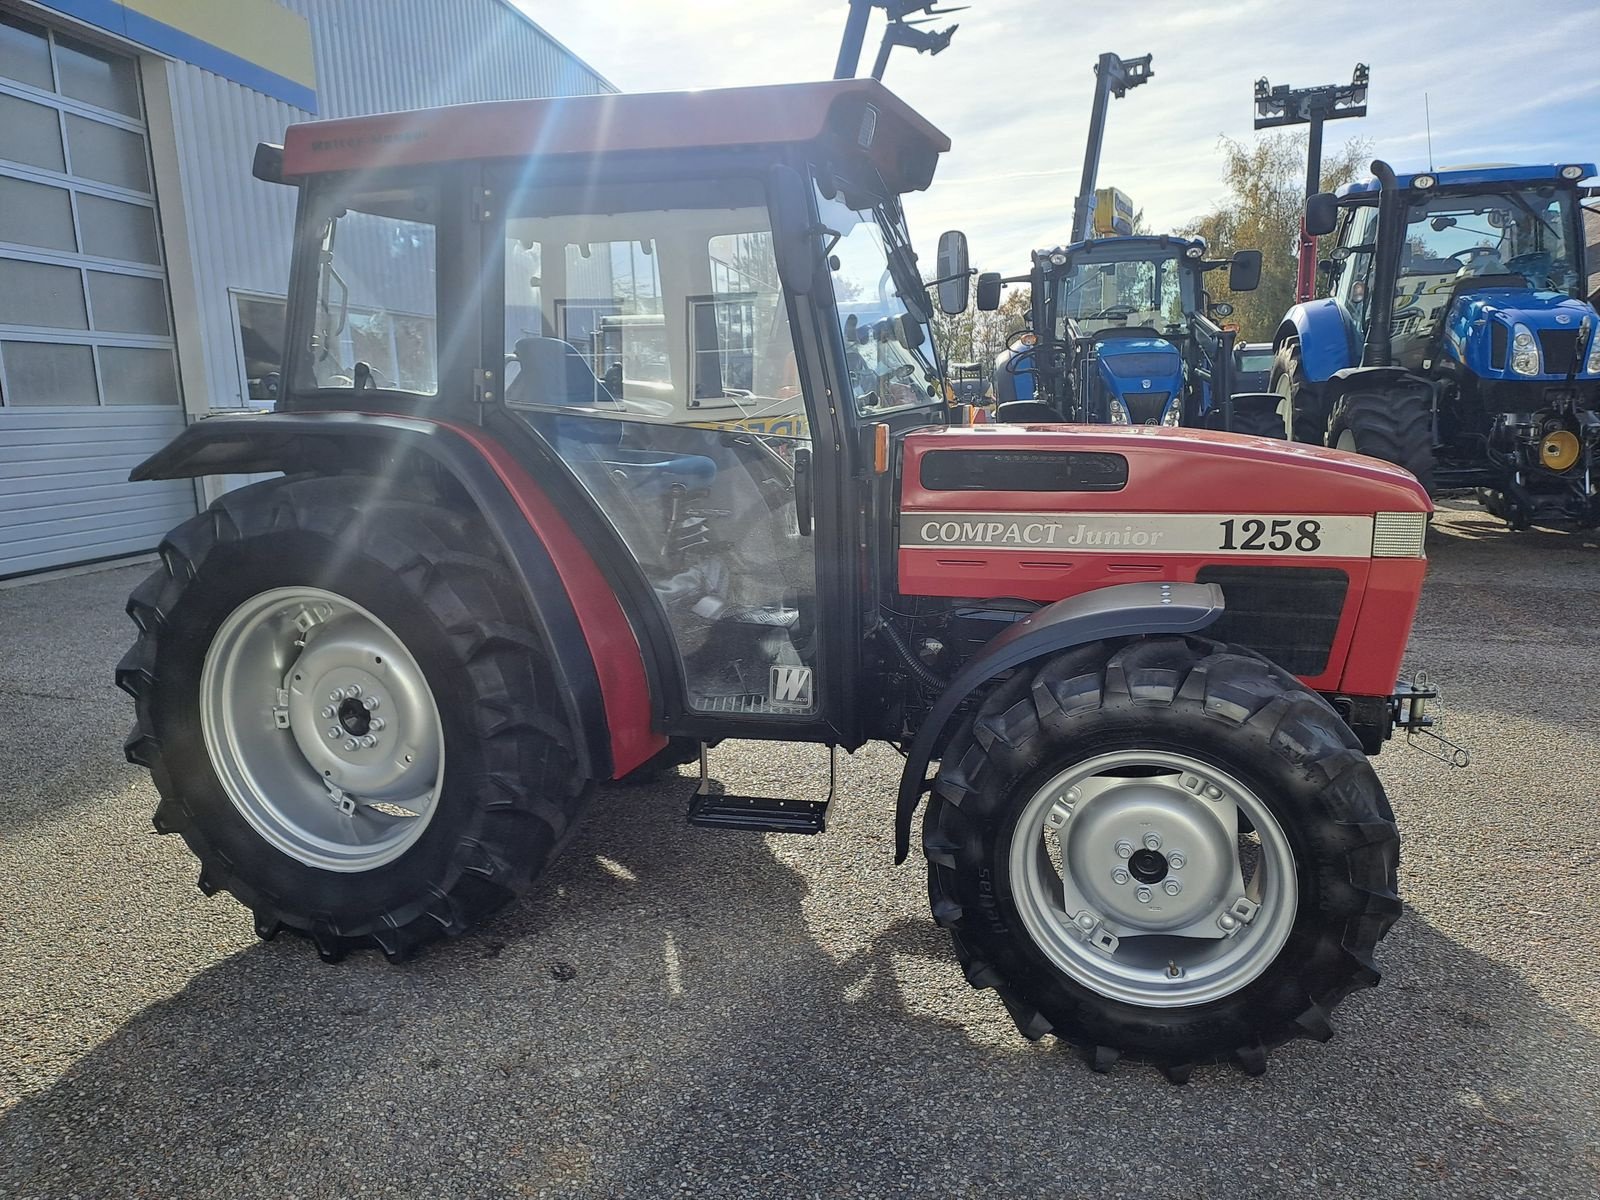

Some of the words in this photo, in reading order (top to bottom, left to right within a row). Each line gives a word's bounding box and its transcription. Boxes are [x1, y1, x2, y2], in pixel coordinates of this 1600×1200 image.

[921, 522, 1062, 544] COMPACT
[1068, 524, 1163, 546] Junior
[1219, 519, 1321, 551] 1258
